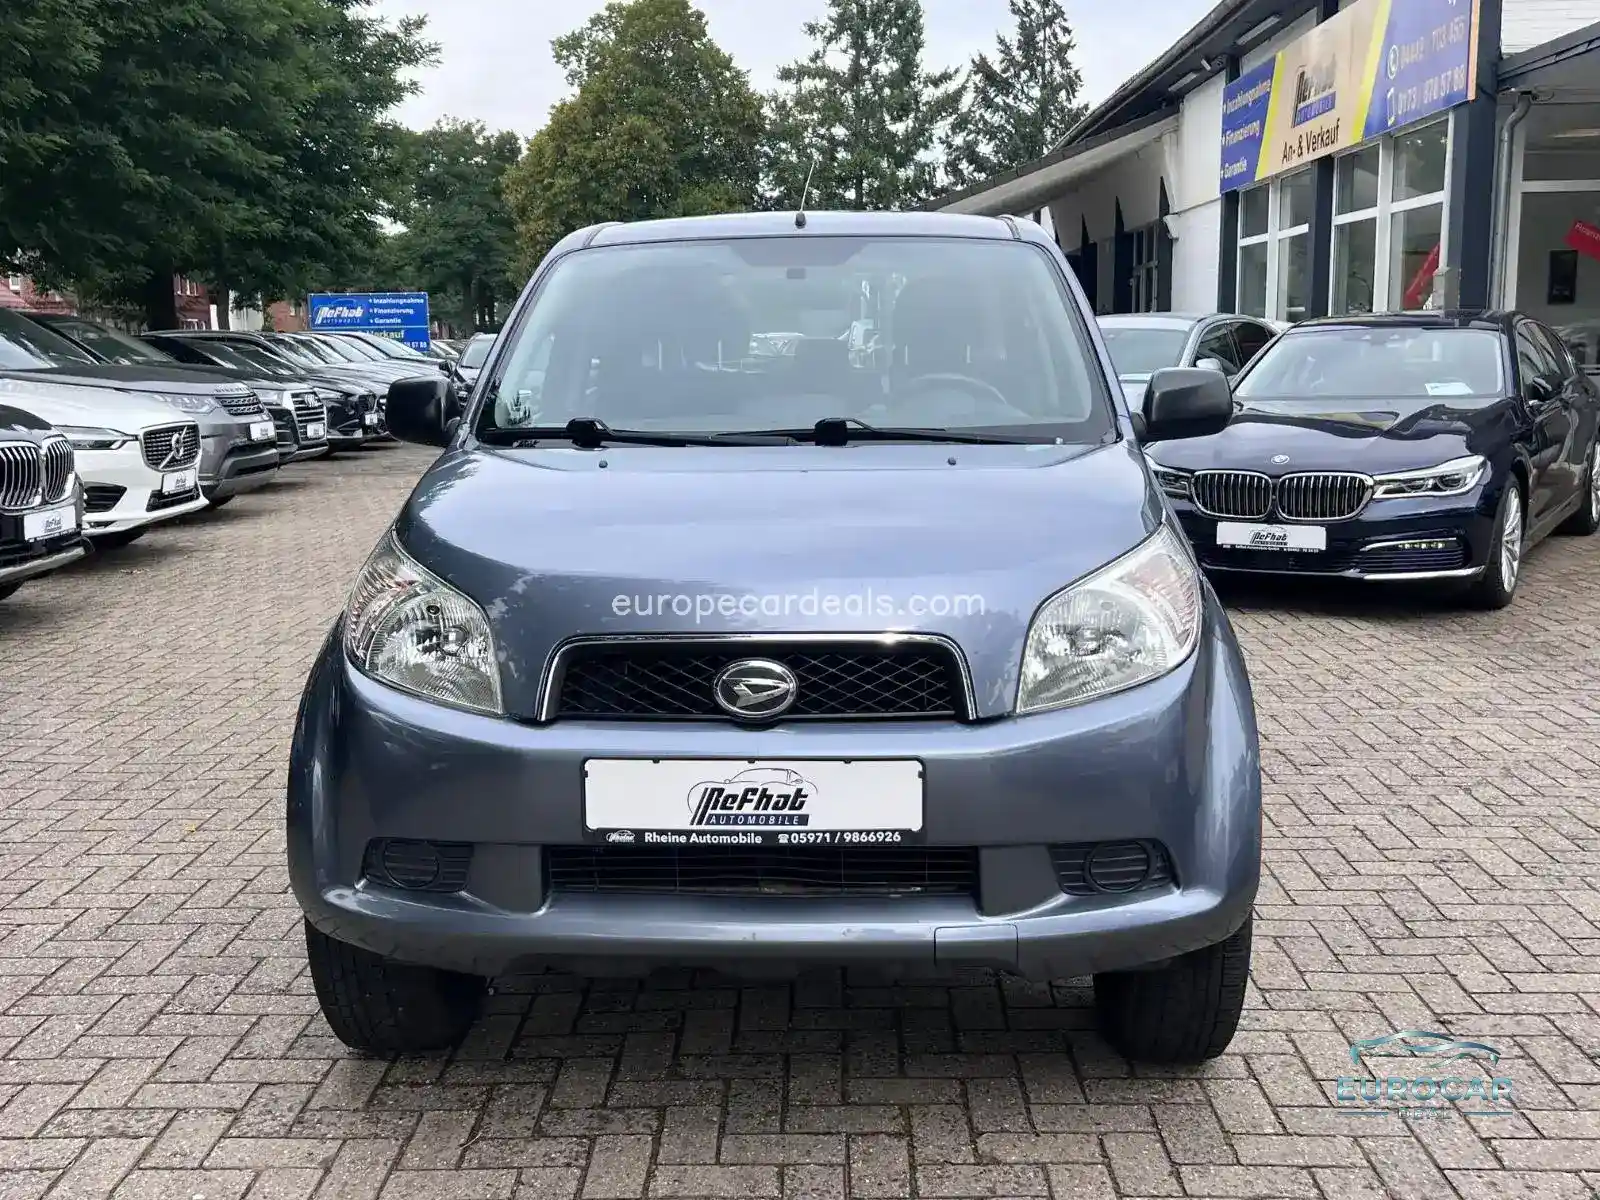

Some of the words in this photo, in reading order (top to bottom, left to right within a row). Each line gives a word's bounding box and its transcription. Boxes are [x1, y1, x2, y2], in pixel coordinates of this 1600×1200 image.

[1281, 142, 1297, 165] An-
[1297, 134, 1304, 158] &
[1305, 117, 1341, 155] Verkauf
[690, 787, 809, 826] Refhat
[710, 815, 800, 825] AUTOMOBILE
[644, 832, 688, 843] Rheine
[689, 831, 763, 844] Automobile
[790, 832, 831, 844] 05971
[843, 831, 901, 843] 9866926
